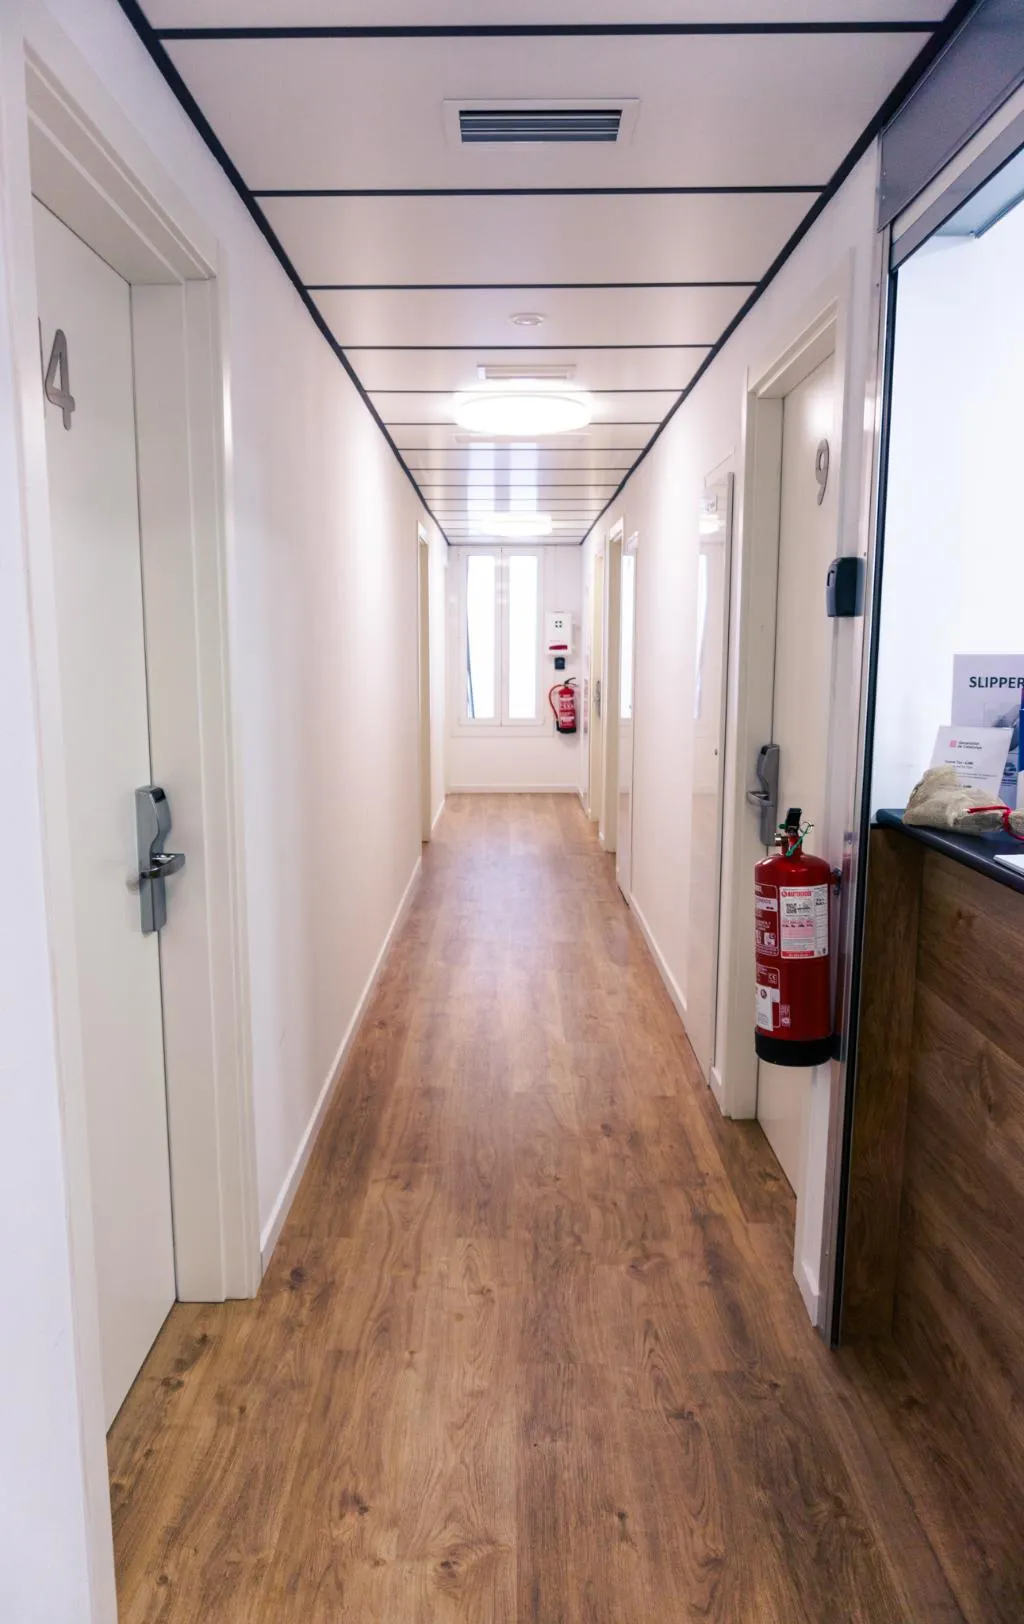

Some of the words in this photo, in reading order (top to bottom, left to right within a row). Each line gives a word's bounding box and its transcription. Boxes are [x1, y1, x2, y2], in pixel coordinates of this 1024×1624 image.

[44, 329, 75, 430] 4
[815, 439, 829, 505] 9
[969, 676, 1024, 688] SLIPPER
